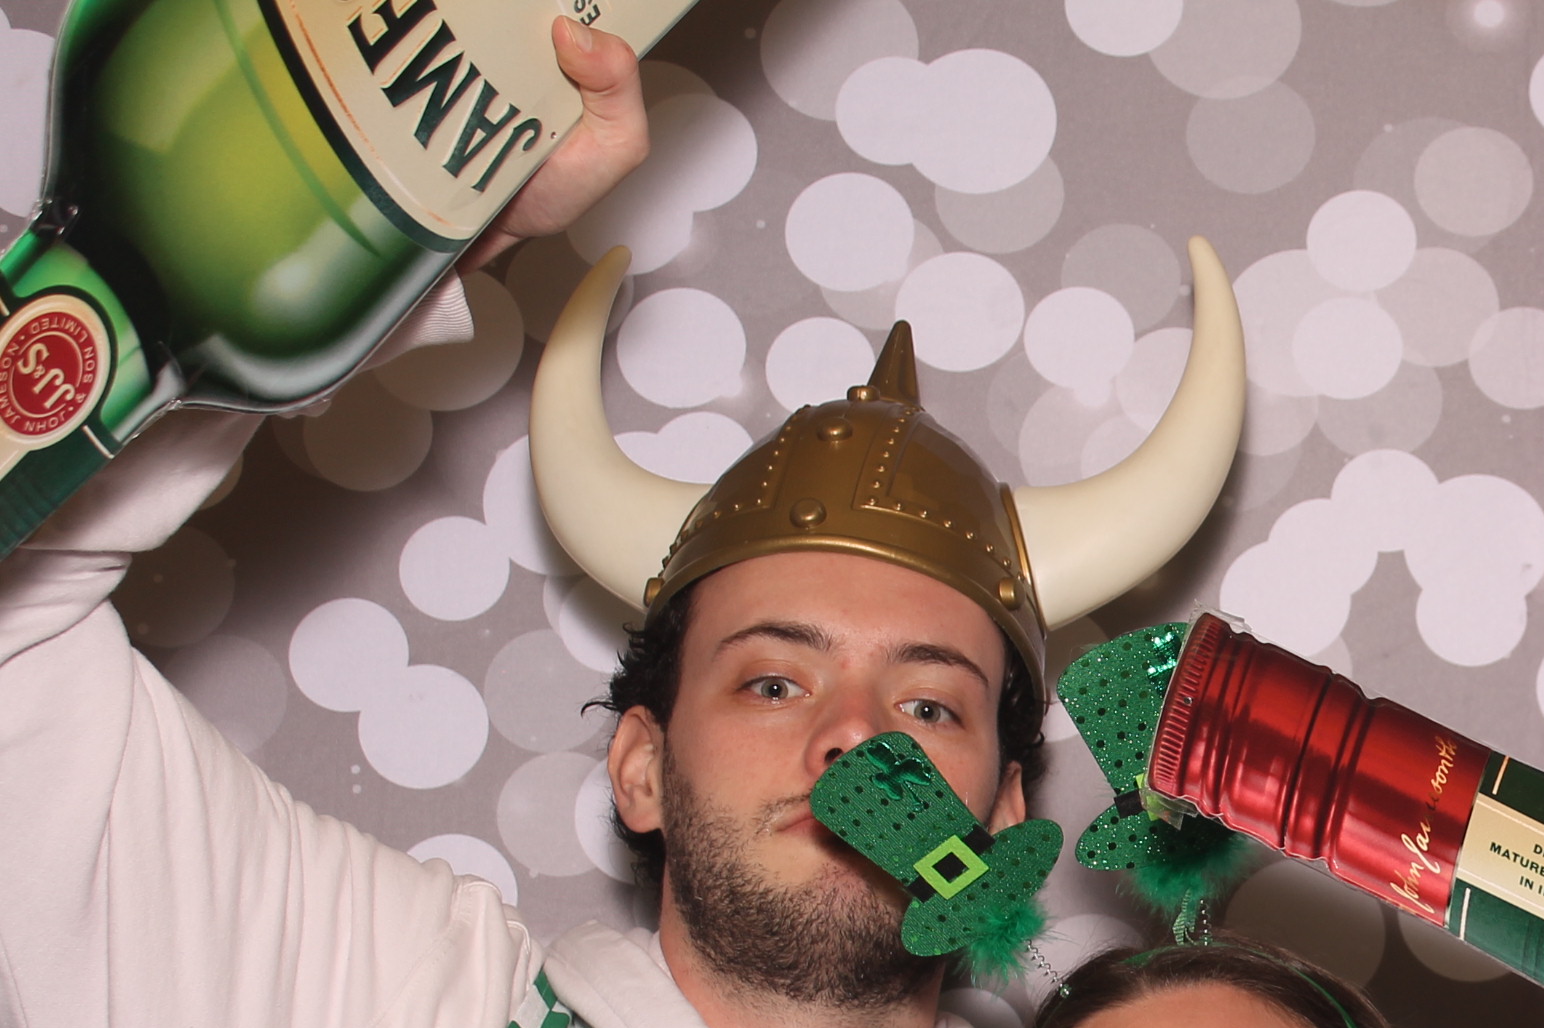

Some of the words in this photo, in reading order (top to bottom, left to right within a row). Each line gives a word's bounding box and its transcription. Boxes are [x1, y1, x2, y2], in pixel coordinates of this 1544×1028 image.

[30, 317, 89, 343] LIMITED
[82, 346, 96, 384] SON
[24, 410, 67, 432] JOHN
[1519, 876, 1535, 891] IN
